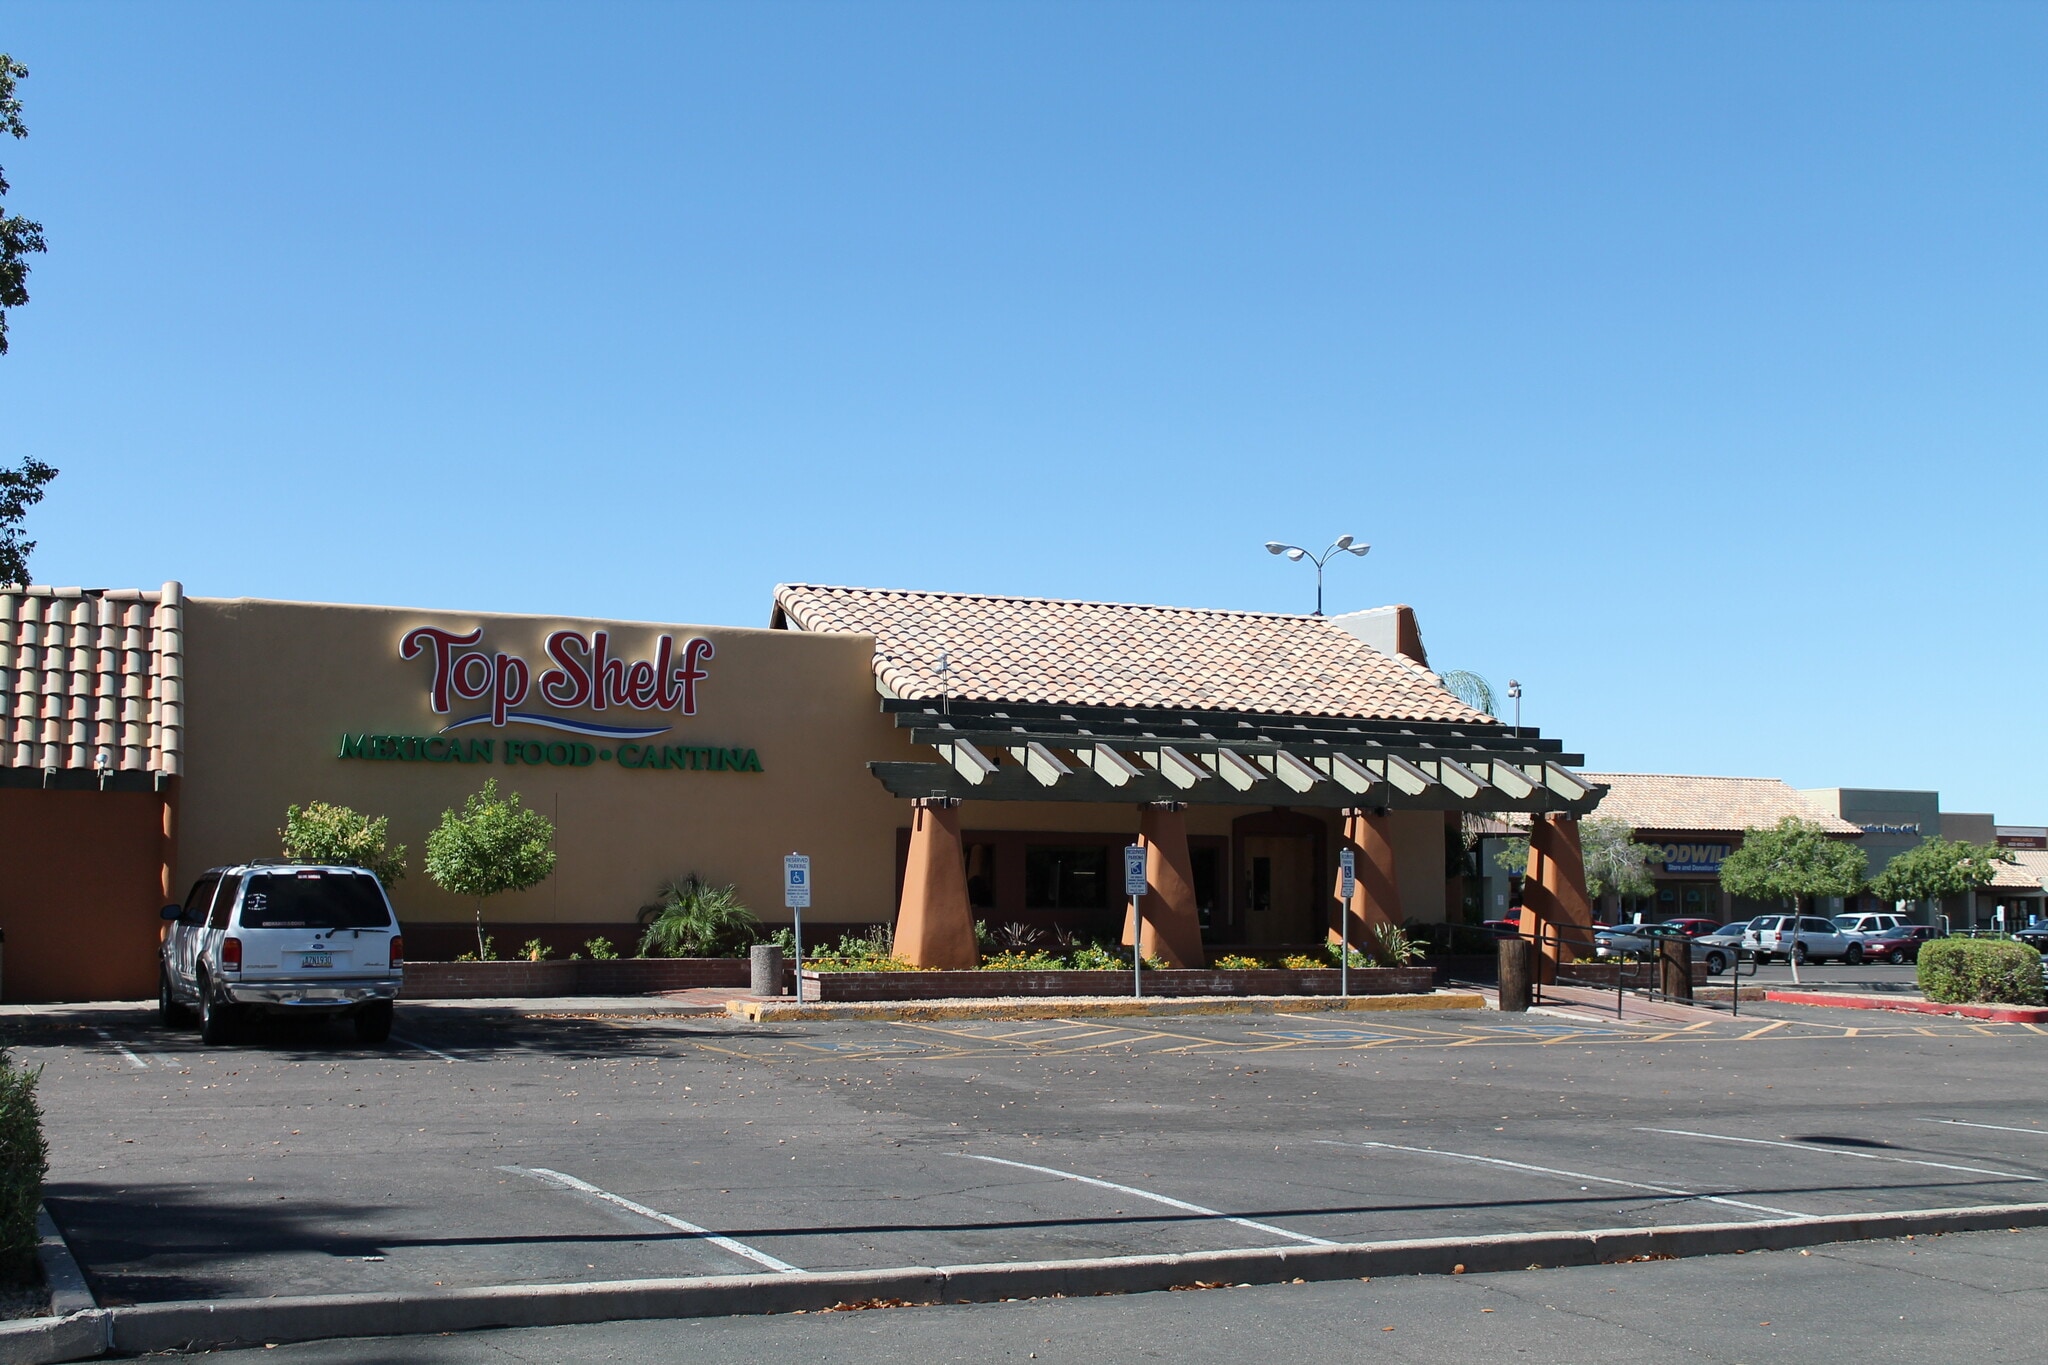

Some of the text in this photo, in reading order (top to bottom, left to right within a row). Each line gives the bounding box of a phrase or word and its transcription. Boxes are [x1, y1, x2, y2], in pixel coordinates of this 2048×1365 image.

[399, 626, 715, 728] Top Shelf
[338, 733, 496, 764] MEXICAN
[617, 744, 764, 772] CANTINA
